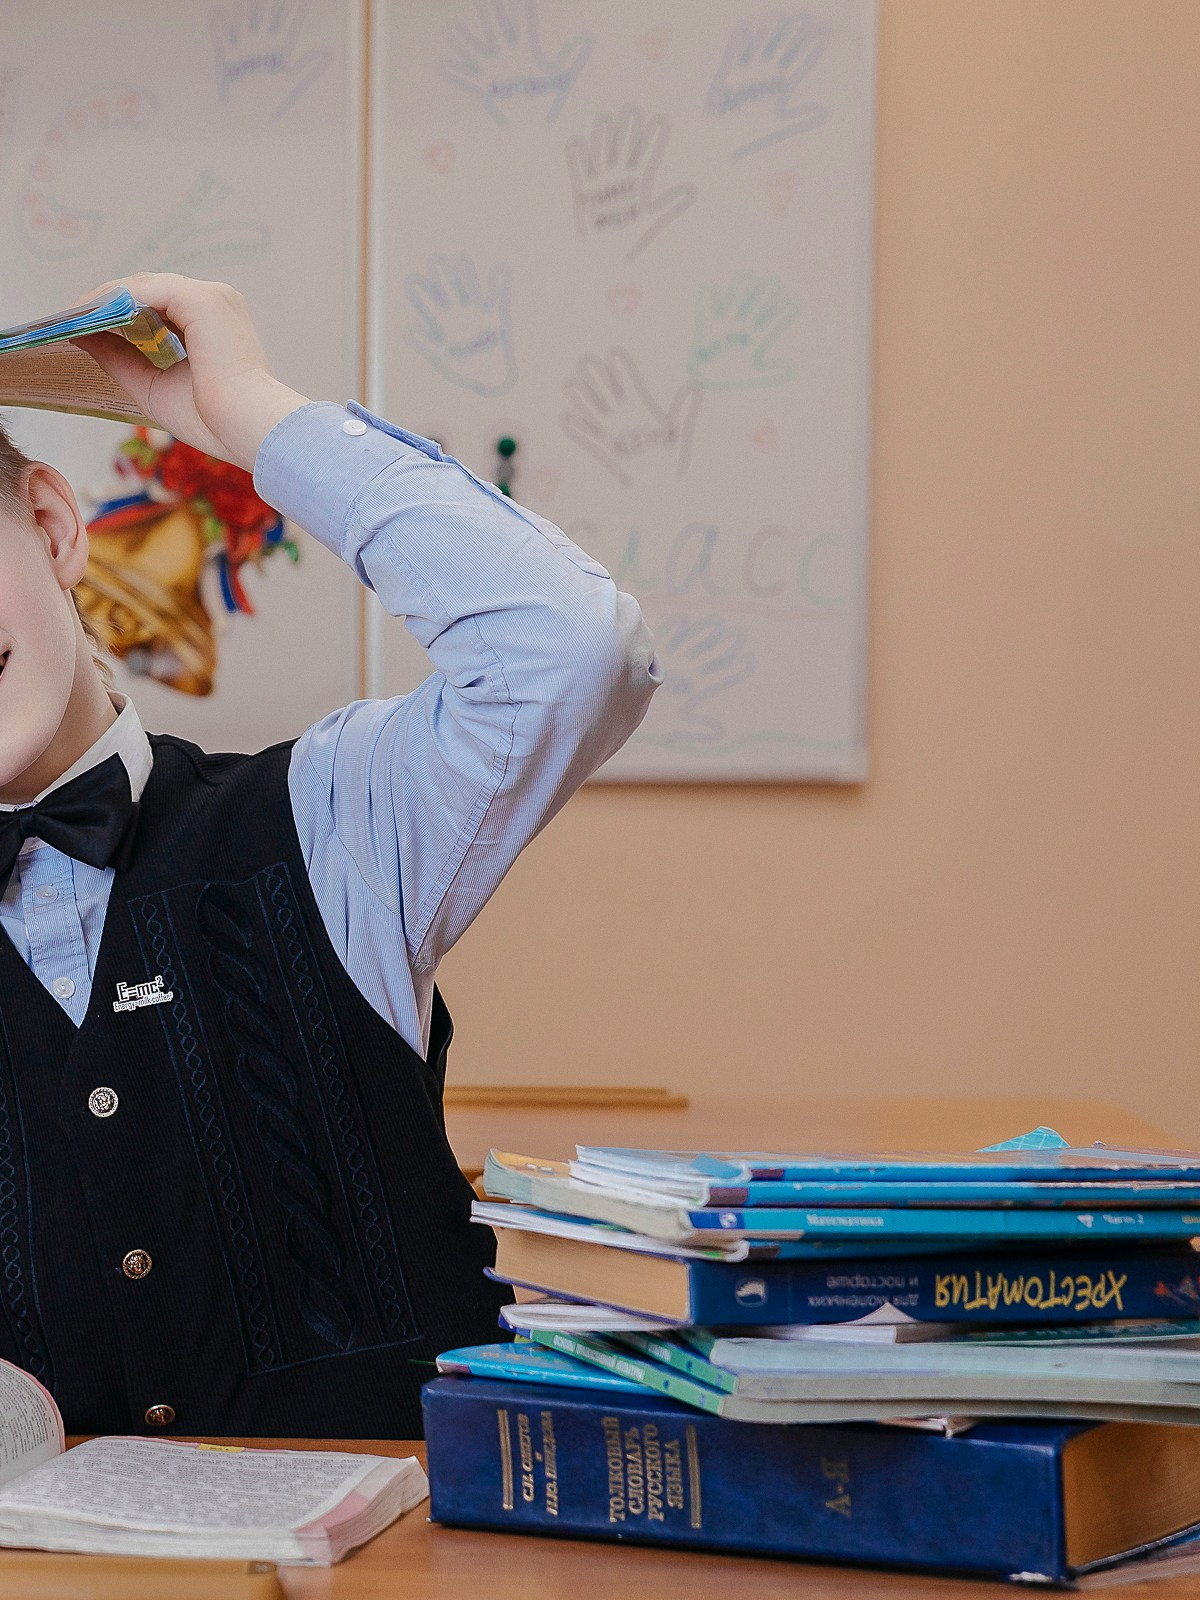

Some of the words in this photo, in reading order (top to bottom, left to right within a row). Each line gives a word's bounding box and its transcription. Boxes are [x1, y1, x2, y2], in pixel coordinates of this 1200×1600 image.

[935, 1270, 1128, 1312] ХРЕСТОМАТИЯ
[517, 1413, 533, 1472] ОЖЕГОВ
[602, 1416, 626, 1523] ТОЛКОВЫЙ
[624, 1426, 646, 1515] СЛОВАРЬ
[642, 1423, 665, 1522] РУССКОГО
[664, 1439, 684, 1510] ЯЗЫКА
